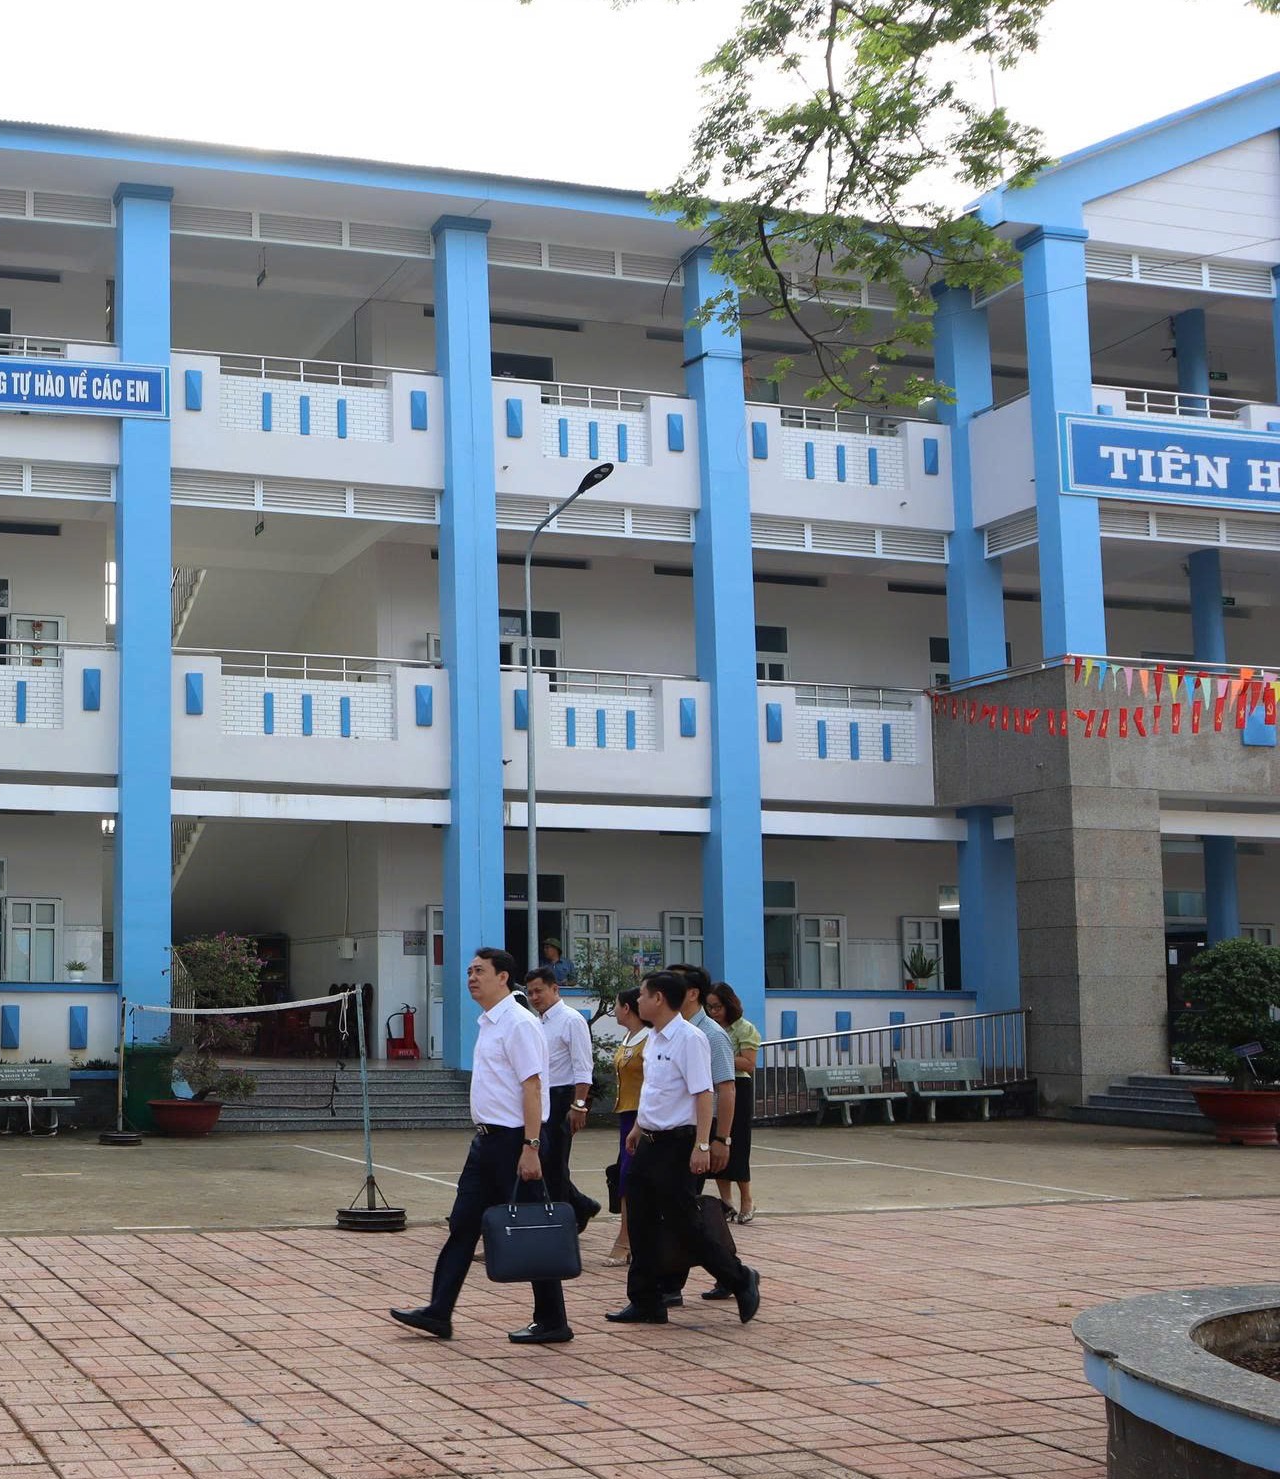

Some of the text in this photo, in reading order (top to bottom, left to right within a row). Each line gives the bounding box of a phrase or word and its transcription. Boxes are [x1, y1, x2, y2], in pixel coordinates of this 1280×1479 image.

[11, 372, 31, 401] TỰ
[34, 369, 65, 398] HÀO
[69, 370, 88, 399] VỀ
[92, 373, 122, 401] CÁC
[126, 379, 150, 403] EM
[1099, 445, 1231, 489] TIÊN
